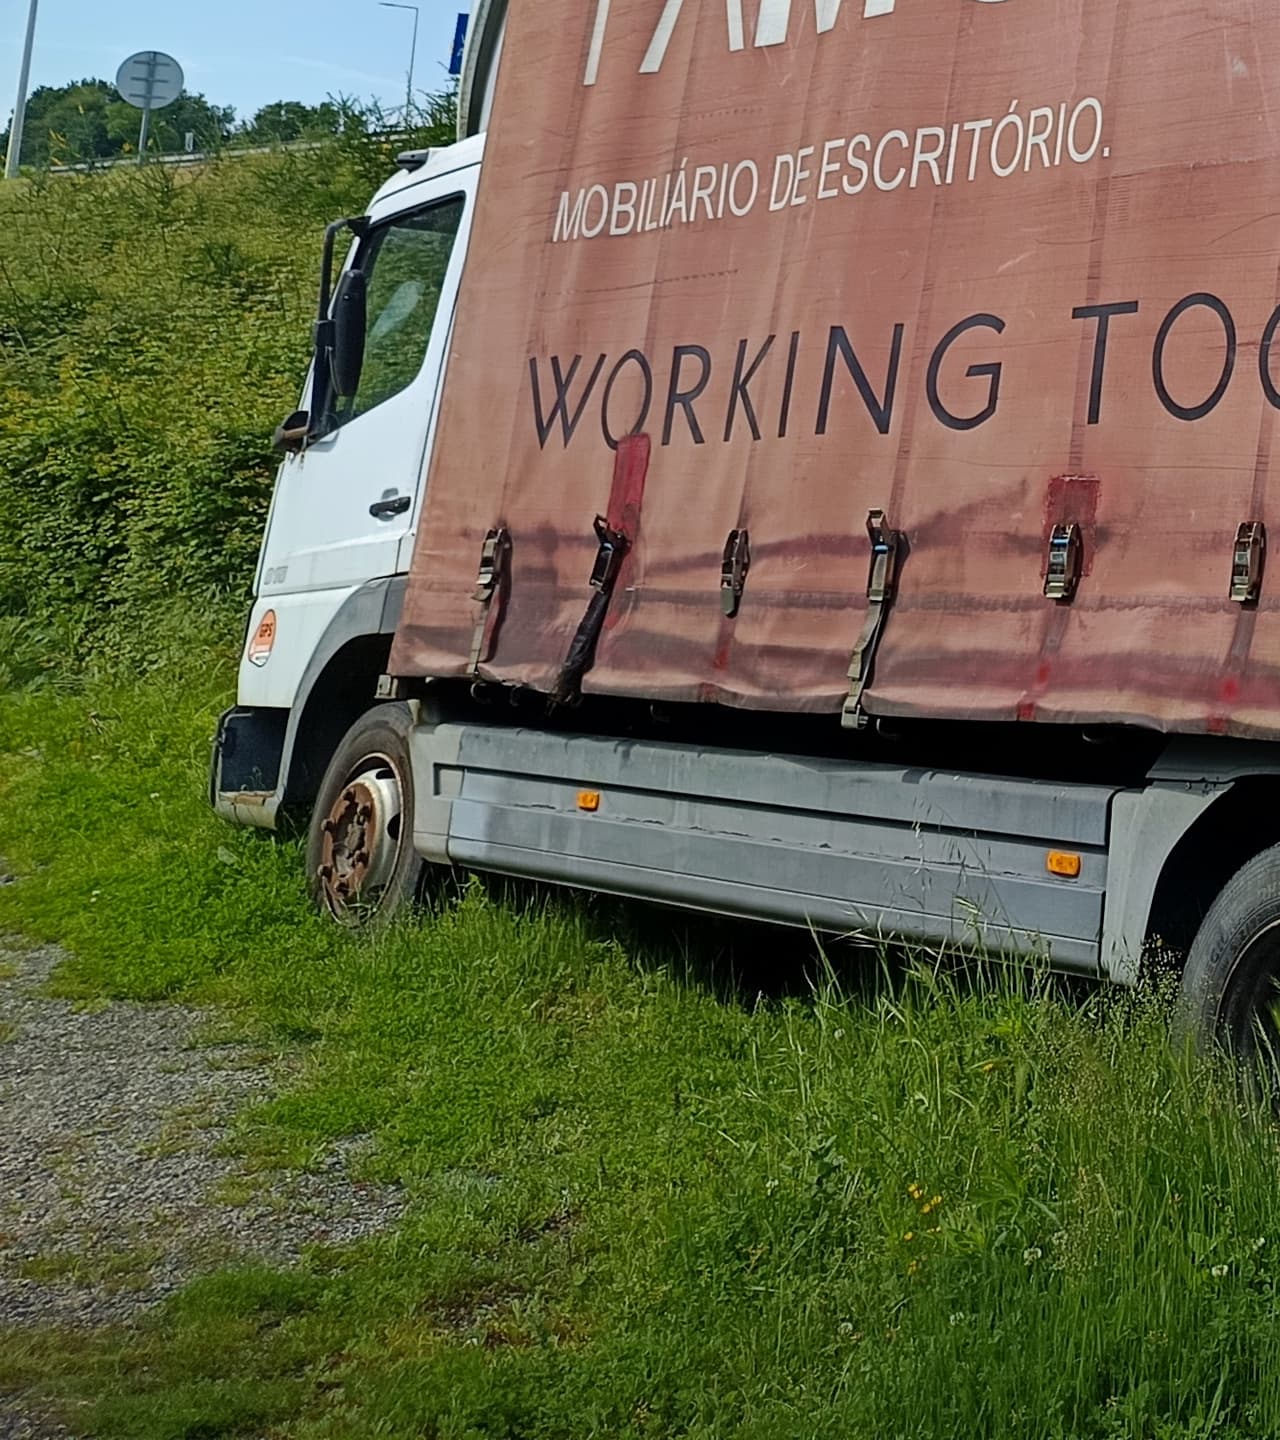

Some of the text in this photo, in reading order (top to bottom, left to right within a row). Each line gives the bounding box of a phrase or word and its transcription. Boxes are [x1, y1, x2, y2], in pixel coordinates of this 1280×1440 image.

[552, 96, 1112, 244] MOBILIÁRIO DE ESCRITÓRIO.
[529, 312, 1007, 451] WORKING
